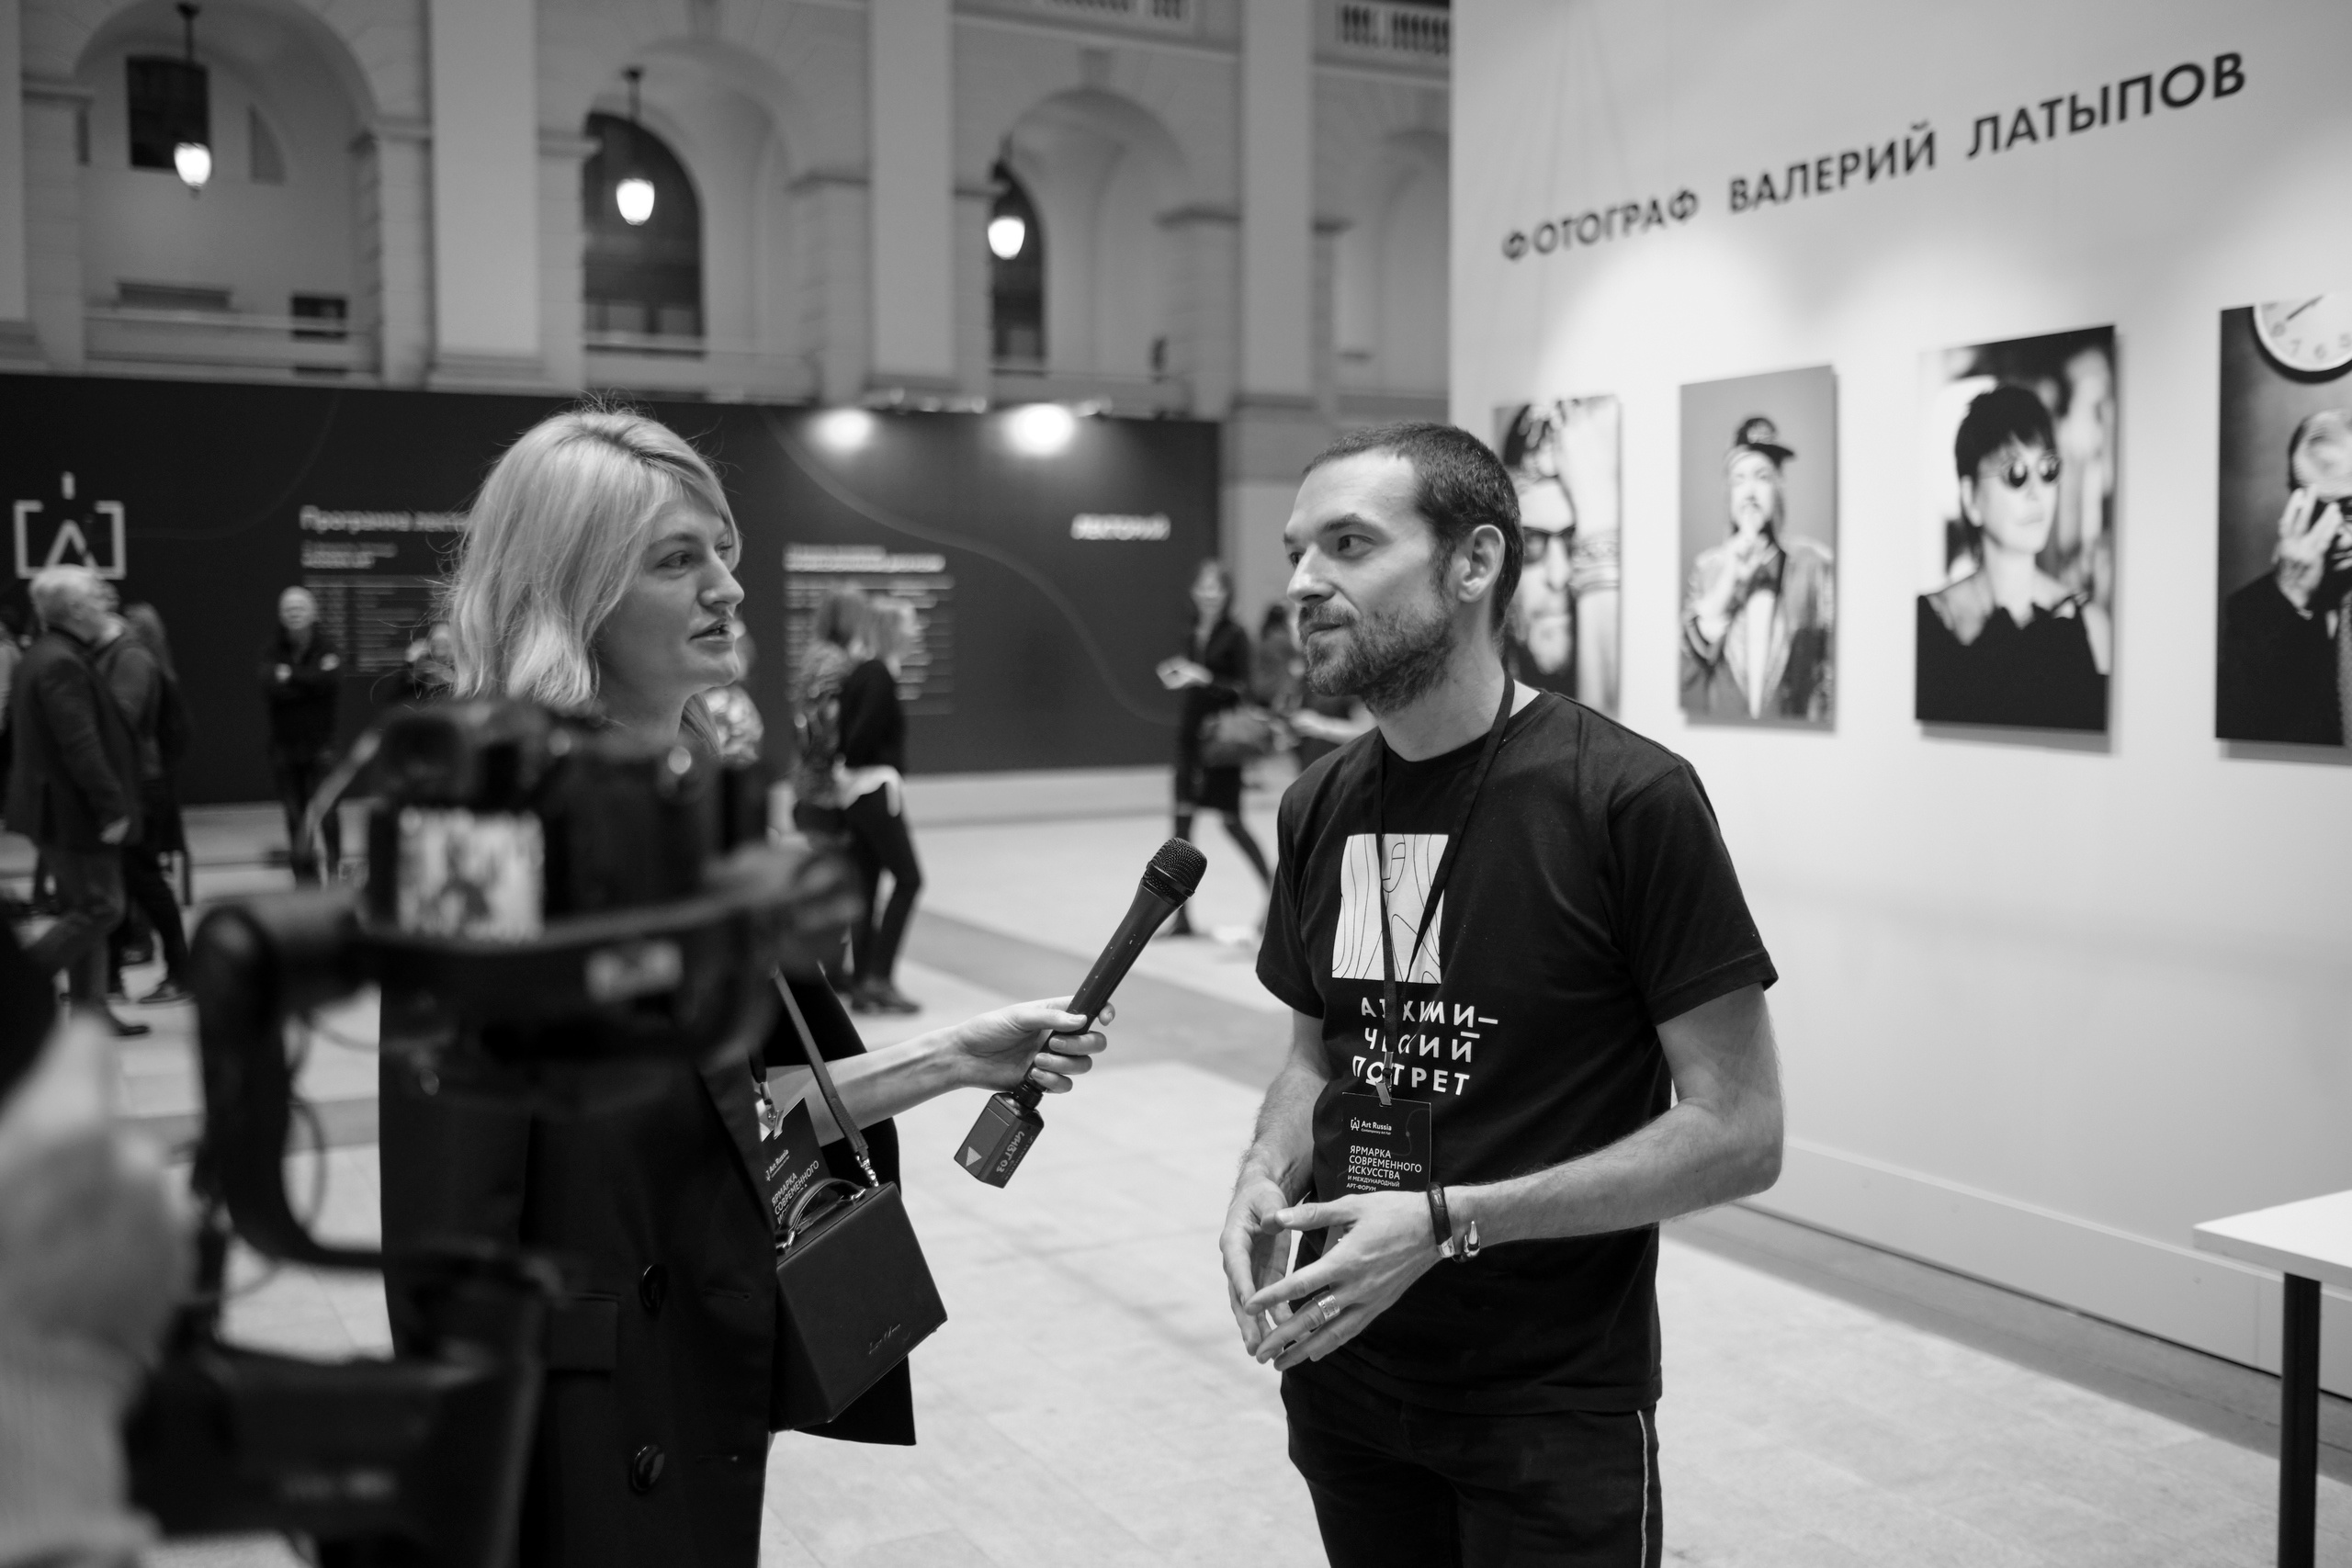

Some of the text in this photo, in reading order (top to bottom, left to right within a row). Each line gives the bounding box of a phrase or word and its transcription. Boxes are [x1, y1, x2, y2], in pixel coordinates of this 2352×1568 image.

[1501, 51, 2247, 262] ФОТОГРАФ ВАЛЕРИЙ ЛАТЫПОВ
[1361, 1121, 1392, 1131] Art Russia
[1350, 1145, 1392, 1159] ЯРМАРКА
[1349, 1155, 1422, 1173] СОВРЕМЕННОГО
[1348, 1165, 1400, 1180] ИСКУССТВА
[772, 1172, 797, 1207] ЯРМАРКА
[775, 1160, 820, 1215] СОВРЕМЕННОГО
[1346, 1182, 1376, 1191] АРТ-ФОРУМ
[1352, 1176, 1400, 1188] МЕЖДУНАРОДНЫЙ
